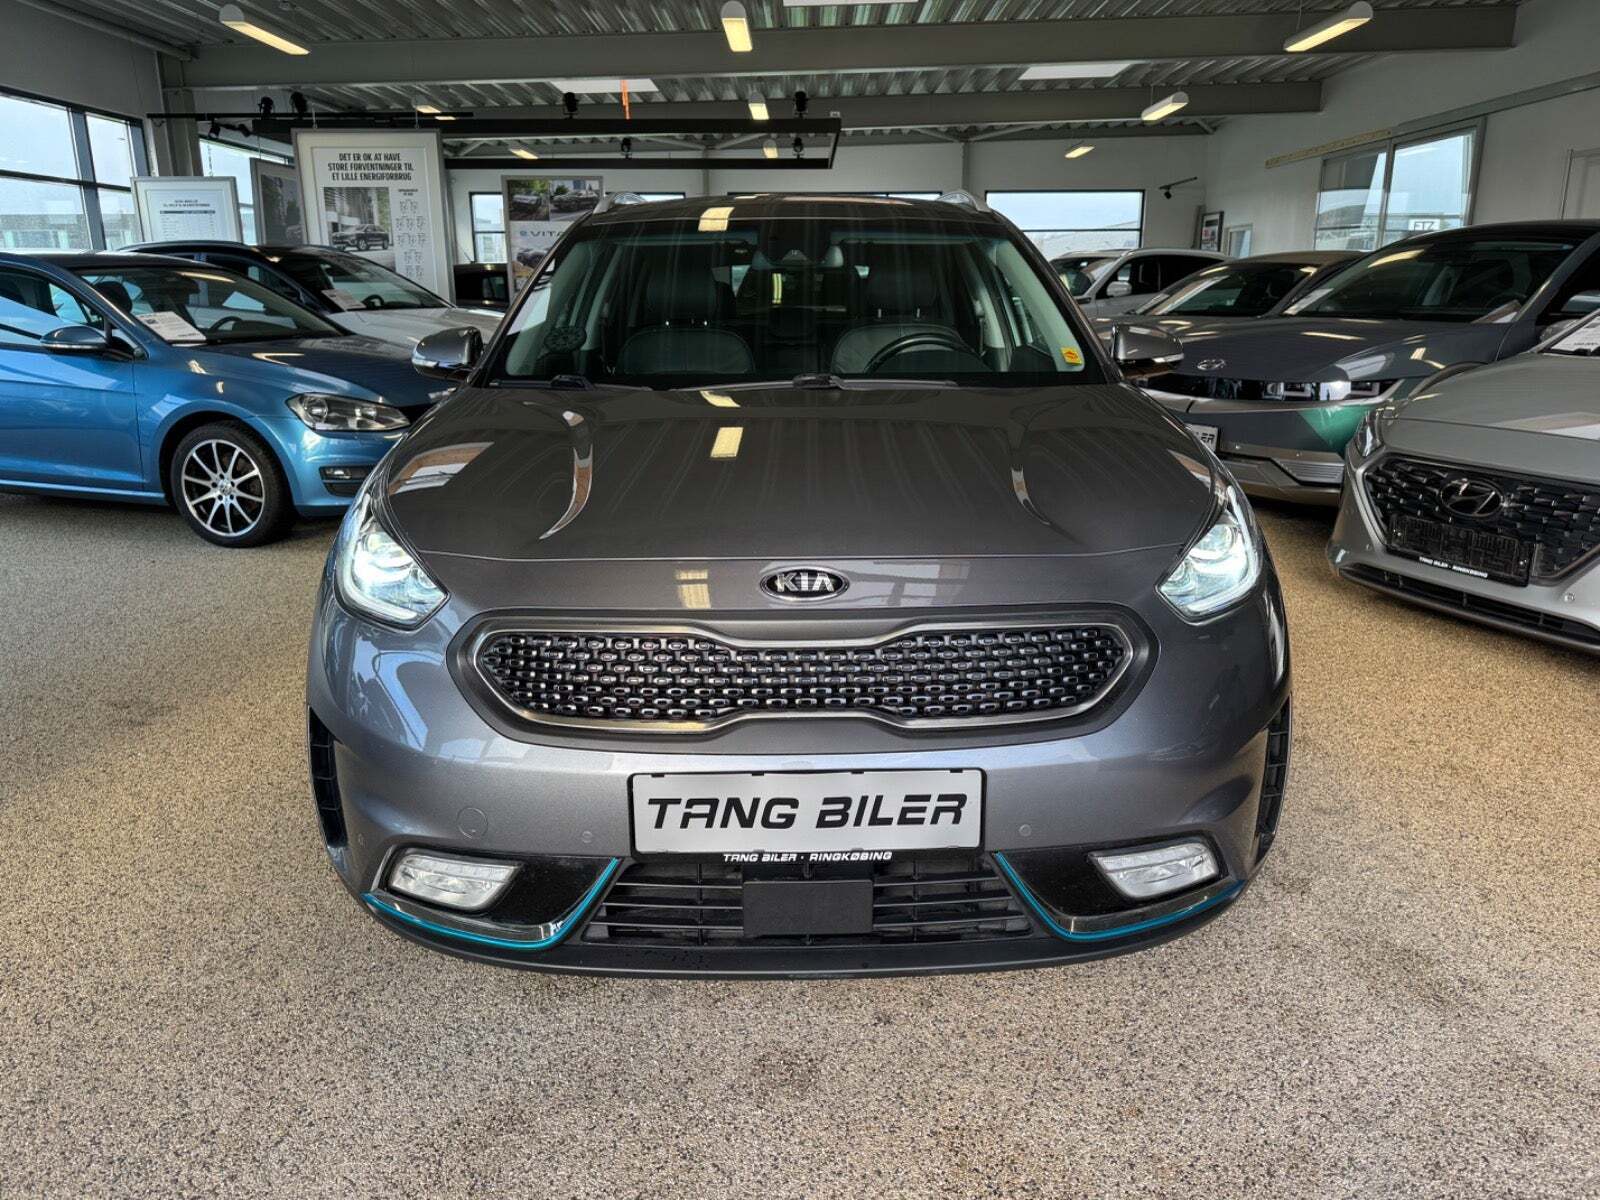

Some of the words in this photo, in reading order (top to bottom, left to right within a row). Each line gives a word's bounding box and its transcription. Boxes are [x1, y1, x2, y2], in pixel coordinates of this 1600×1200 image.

[339, 153, 351, 161] DET
[353, 152, 361, 161] ER
[362, 152, 372, 161] OK
[374, 152, 382, 161] AT
[383, 152, 401, 161] HAVE
[327, 162, 348, 171] STORE
[350, 162, 402, 171] FORVENTNINGER
[332, 172, 340, 181] ET
[341, 172, 358, 181] LILLE
[360, 172, 412, 181] ENERGIFORBRUG
[774, 571, 835, 593] KIA
[647, 797, 800, 830] TANG
[814, 793, 968, 829] BILER
[722, 853, 758, 863] TANG
[761, 852, 797, 863] BILER
[808, 851, 893, 862] RINGKØBING
